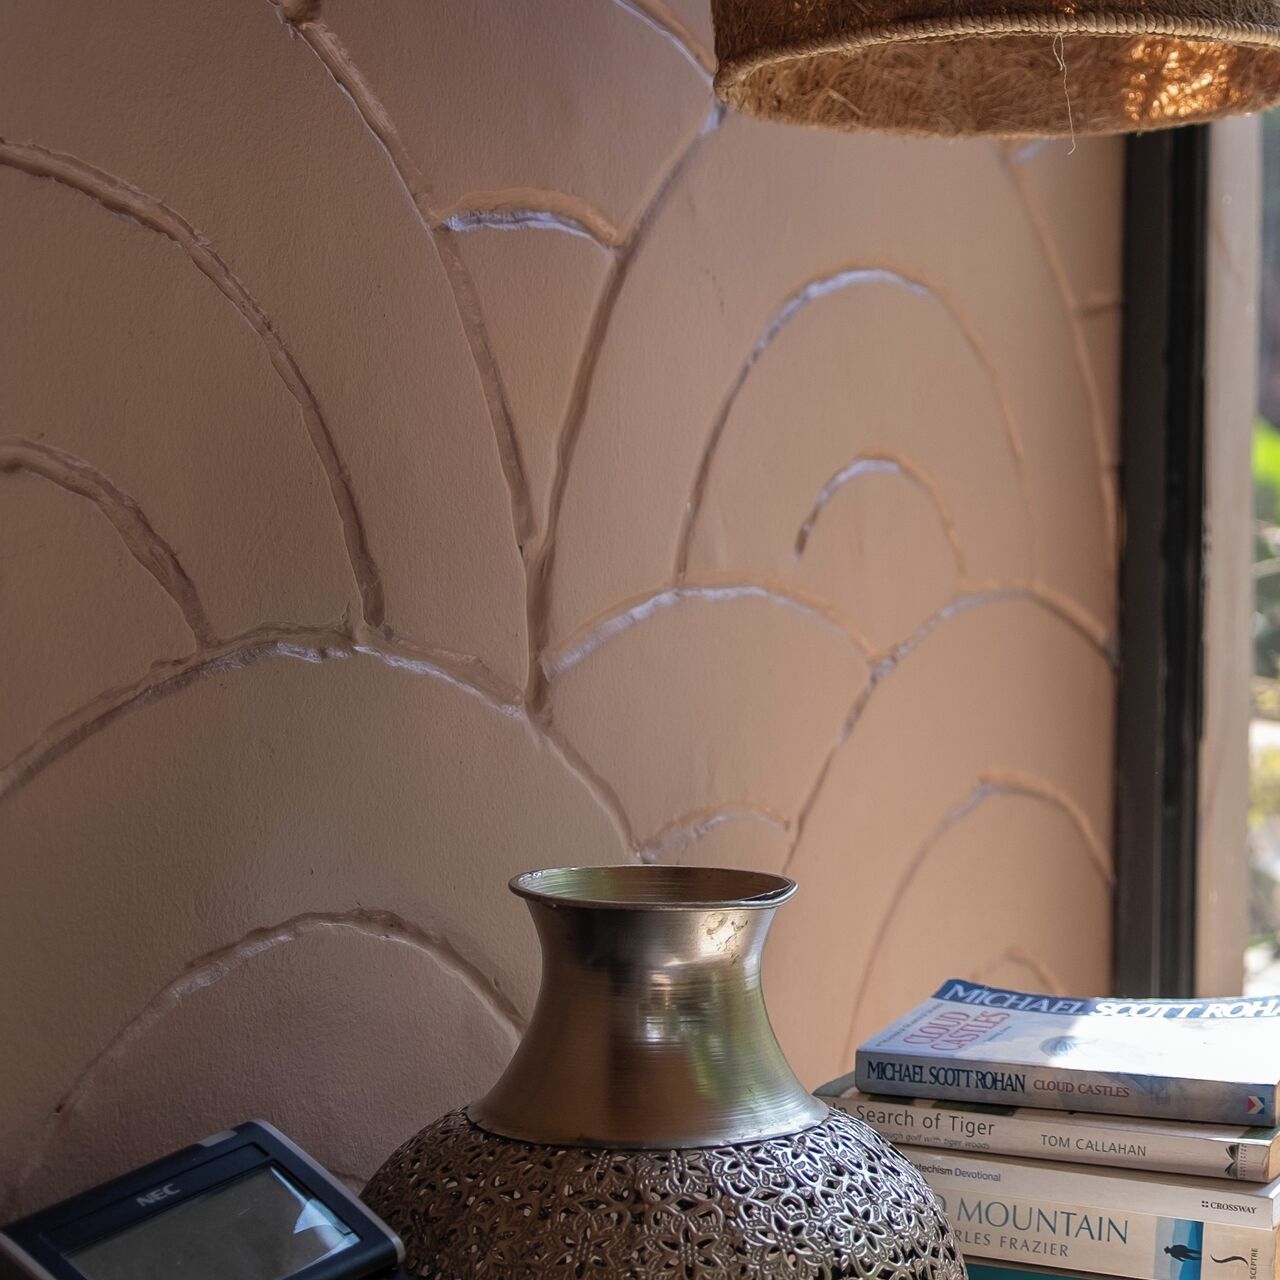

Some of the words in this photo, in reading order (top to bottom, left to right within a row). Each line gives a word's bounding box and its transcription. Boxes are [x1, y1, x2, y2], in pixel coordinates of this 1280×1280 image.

[943, 983, 1084, 1014] MICHAEL
[1093, 1001, 1202, 1018] SCOTT
[904, 1011, 971, 1045] CLOUD
[930, 1009, 1010, 1052] CASTLES
[867, 1060, 927, 1085] MICHAEL
[929, 1066, 975, 1090] SCOTT
[974, 1071, 1026, 1094] ROHAN
[1033, 1078, 1075, 1093] CLOUD
[1077, 1082, 1130, 1098] CASTLES
[856, 1105, 914, 1128] Search
[922, 1112, 941, 1130] of
[949, 1114, 996, 1138] Tiger
[1040, 1133, 1071, 1149] TOM
[1075, 1137, 1147, 1158] CALLAHAN
[954, 1167, 1002, 1182] Devotional
[135, 1183, 181, 1207] NEC
[1210, 1200, 1256, 1215] CROSSWAY
[956, 1196, 1128, 1246] MOUNTAIN
[999, 1234, 1069, 1257] FRAZIER
[1249, 1247, 1259, 1280] SCEPTRE
